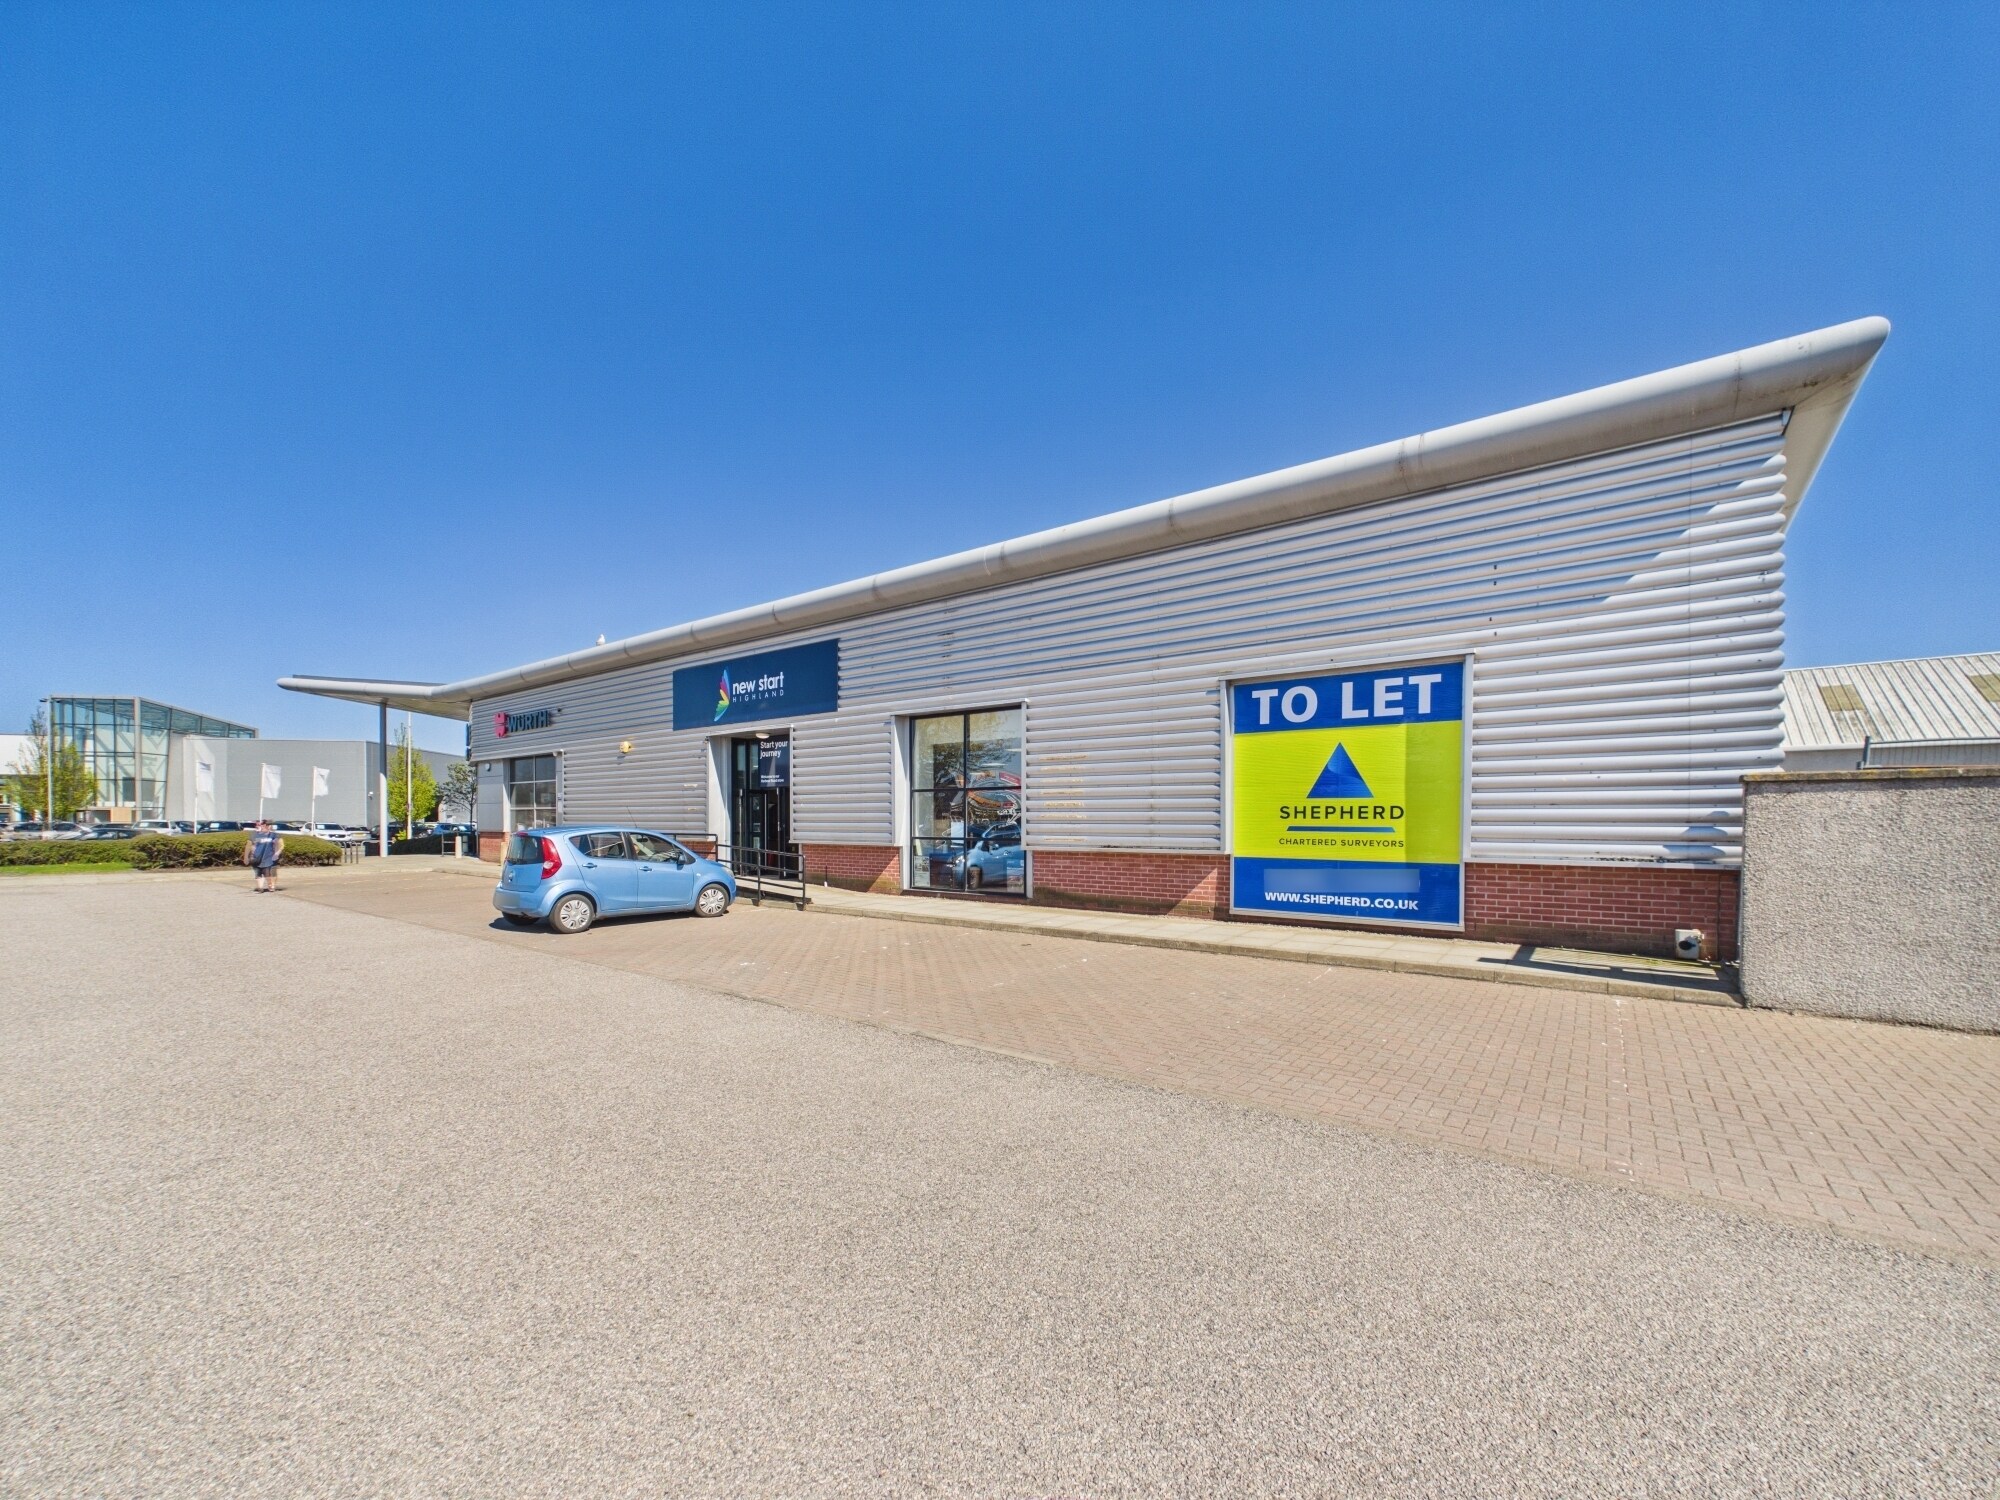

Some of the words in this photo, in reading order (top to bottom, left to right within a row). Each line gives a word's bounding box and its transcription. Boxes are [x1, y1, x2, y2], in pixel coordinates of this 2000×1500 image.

[733, 680, 756, 695] new
[758, 671, 784, 690] start
[733, 689, 784, 702] HIGHLAND
[1251, 685, 1318, 725] TO
[1341, 673, 1441, 720] LET
[760, 741, 774, 749] Start
[775, 740, 788, 750] your
[1279, 805, 1404, 819] SHEPHERD
[1278, 838, 1337, 846] CHARTERED
[1340, 839, 1404, 847] SURVEYORS
[1264, 892, 1419, 911] WWW.SHEPHERD.CO.UK
